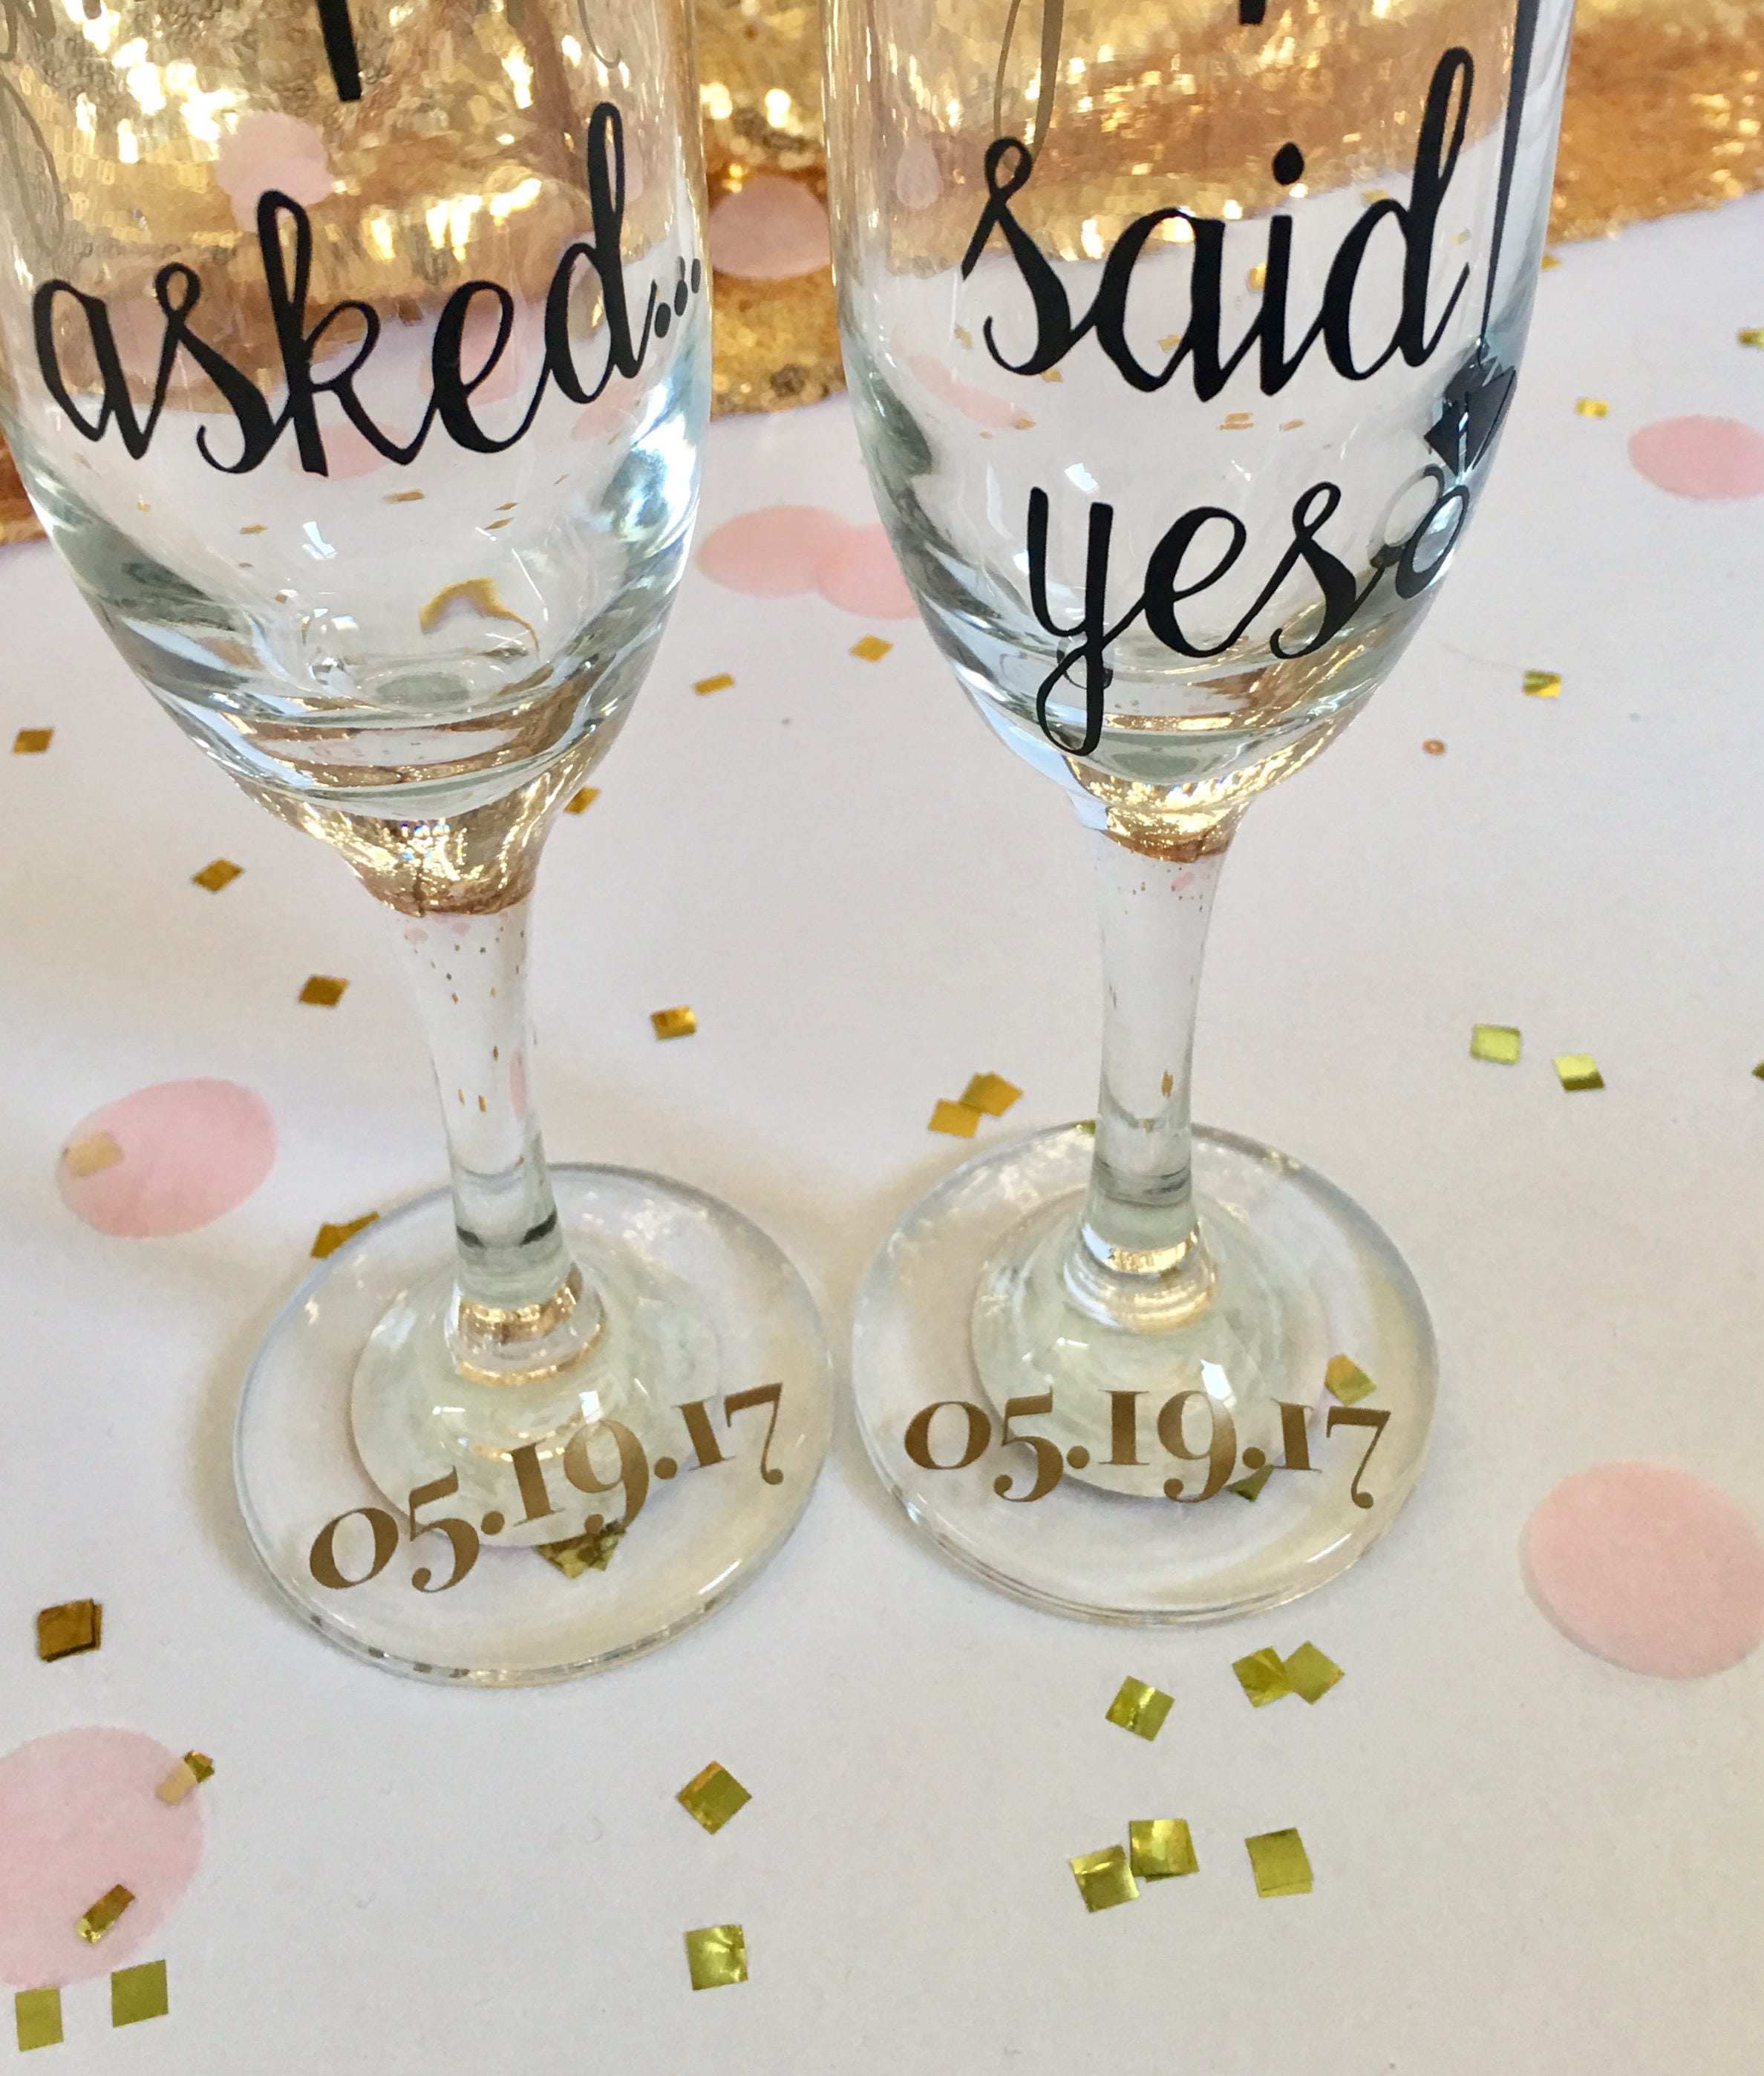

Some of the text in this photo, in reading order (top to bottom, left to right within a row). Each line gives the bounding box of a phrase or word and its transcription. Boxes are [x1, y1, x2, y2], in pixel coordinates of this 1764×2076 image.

[961, 46, 1471, 402] said
[1026, 481, 1387, 757] yes
[310, 1382, 784, 1593] 05.19.17
[904, 1387, 1391, 1509] 05.19.17
